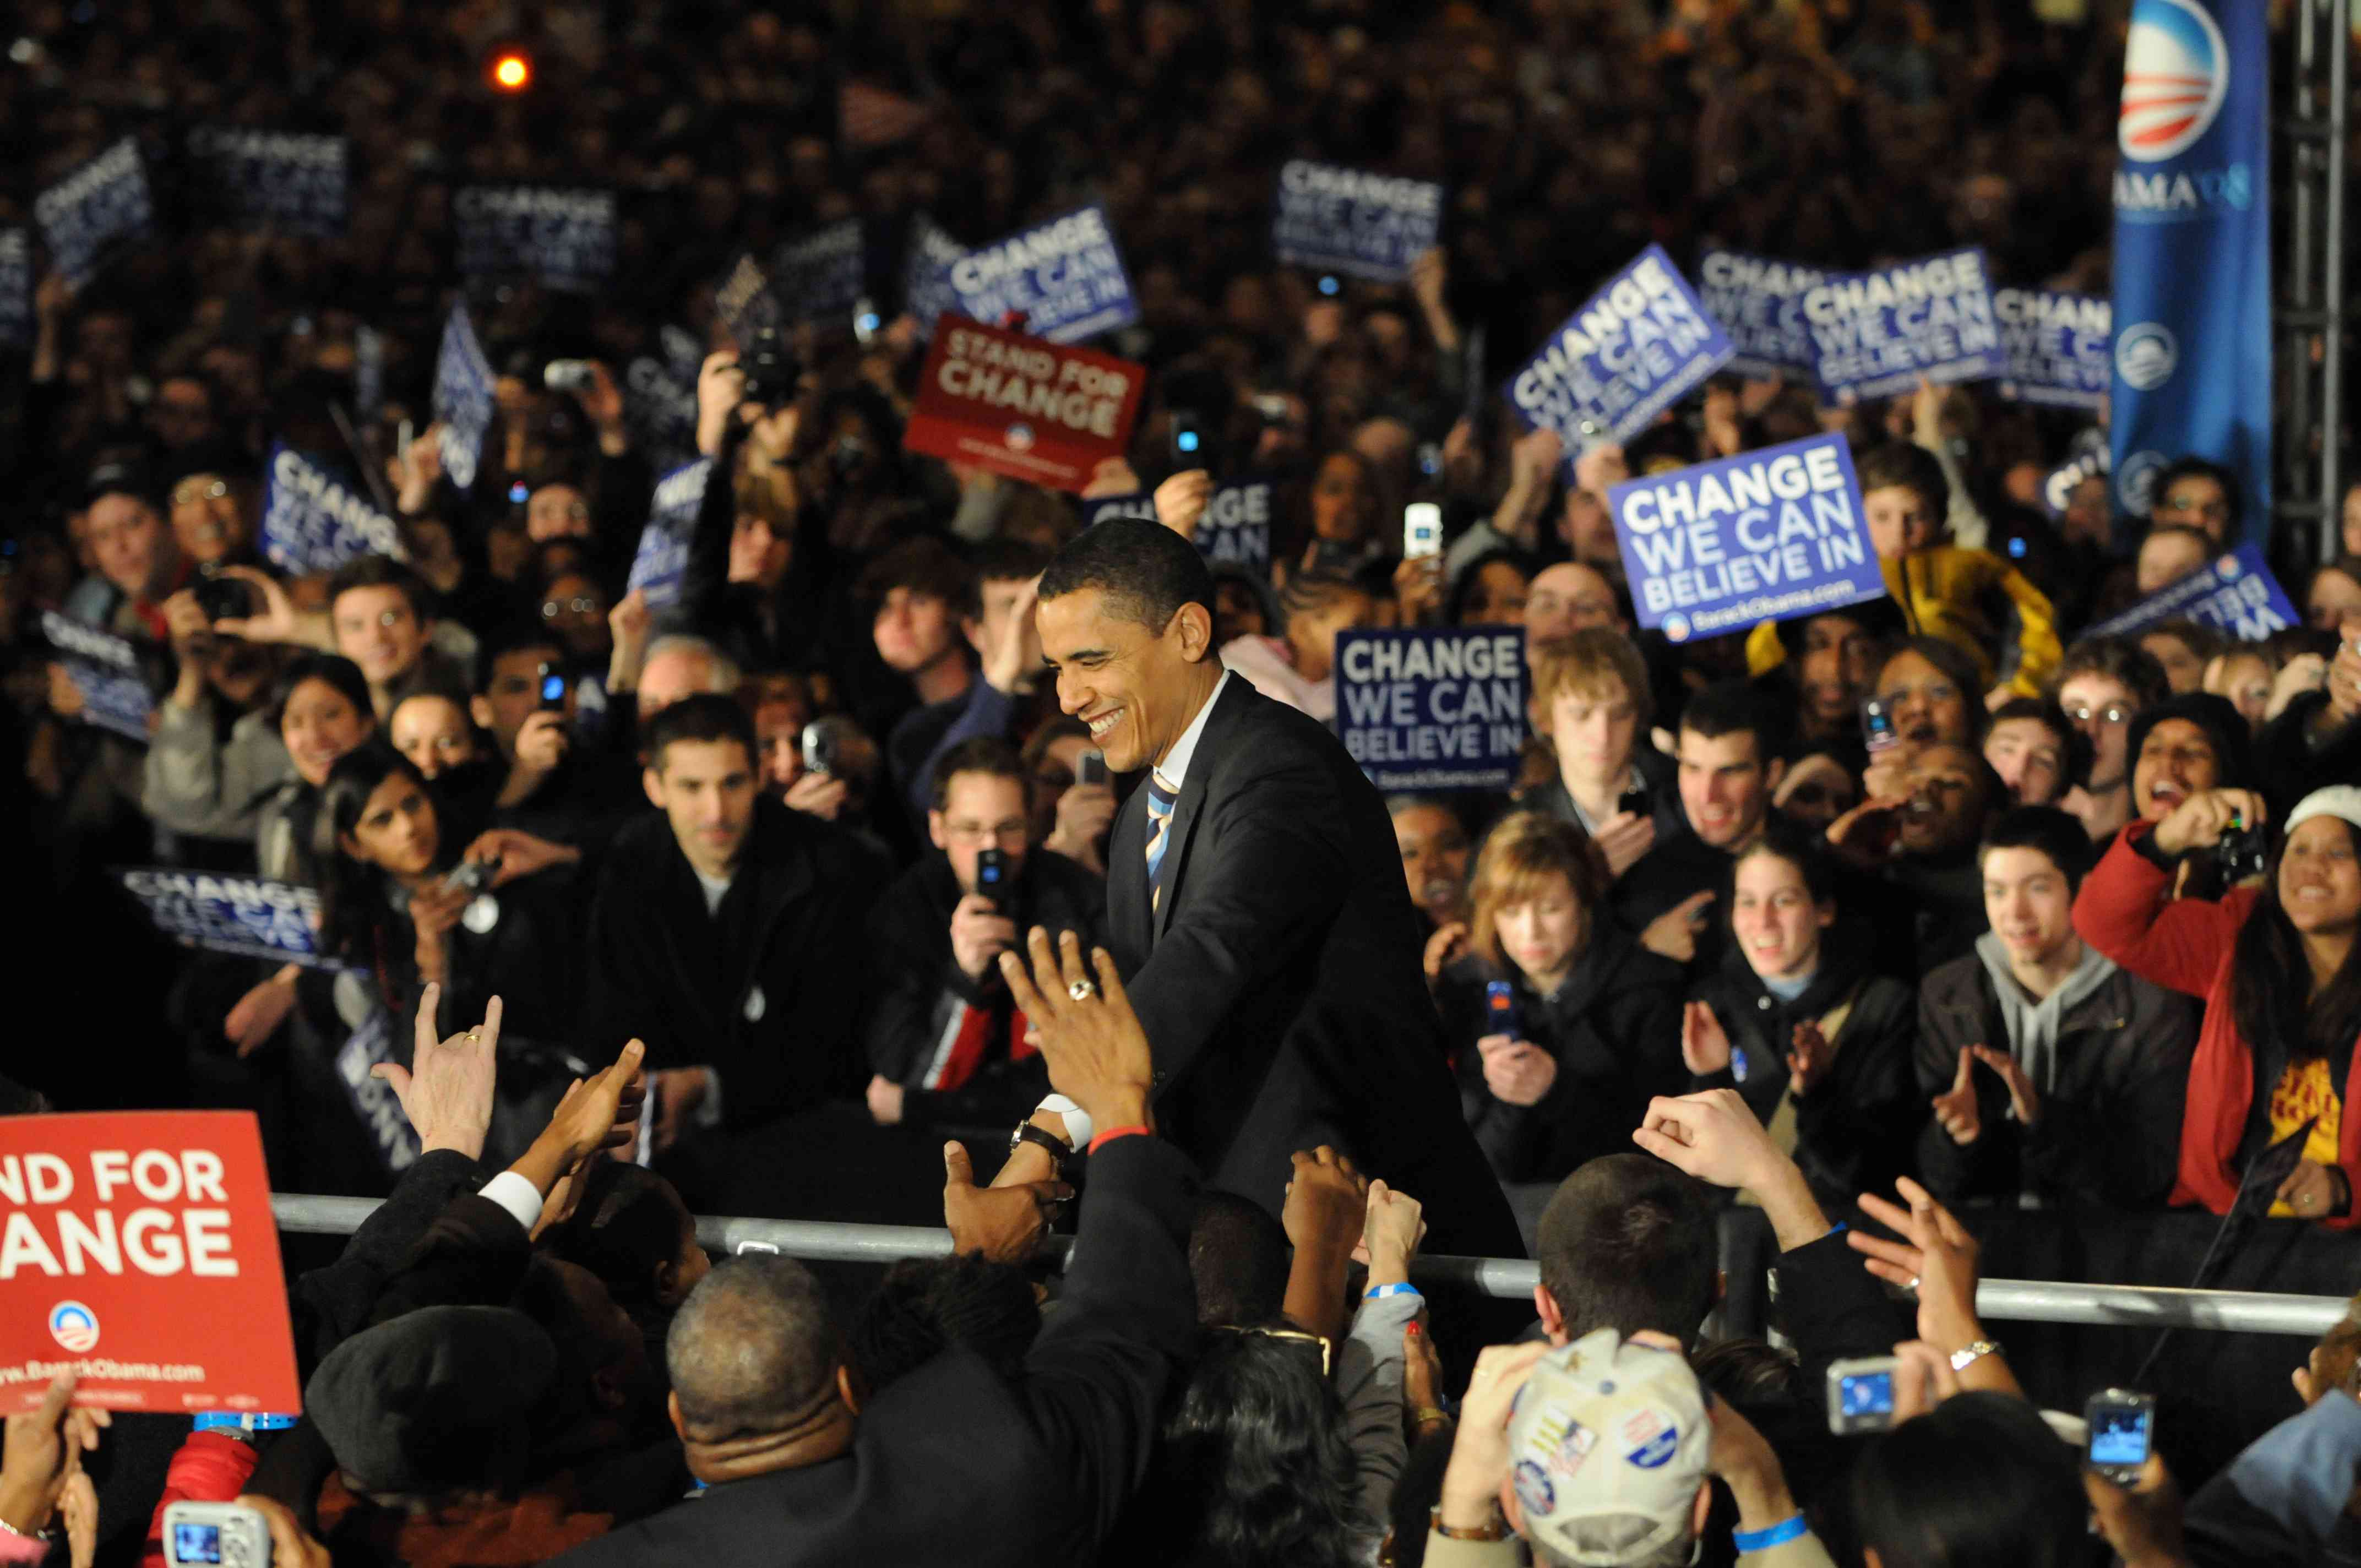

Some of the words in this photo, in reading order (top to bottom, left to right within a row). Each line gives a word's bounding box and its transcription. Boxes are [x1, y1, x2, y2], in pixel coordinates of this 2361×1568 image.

[1281, 159, 1443, 211] CHANGE
[951, 206, 1109, 295] CHANGE
[1035, 243, 1120, 295] CAN
[1803, 252, 1981, 326] CHANGE
[1514, 256, 1674, 410] CHANGE
[1600, 286, 1695, 372] CAN
[1811, 304, 1886, 358] WE
[1895, 290, 1993, 337] CAN
[949, 327, 1056, 380] STAND
[1059, 360, 1129, 398] FOR
[1820, 333, 1957, 385] BELIEVE
[938, 357, 1119, 439] CHANGE
[1623, 444, 1846, 534] CHANGE
[1630, 518, 1726, 577] WE
[1735, 488, 1856, 553] CAN
[1642, 542, 1813, 614] BELIEVE
[1818, 530, 1865, 573] IN
[1691, 579, 1856, 631] BarackObama.com
[1341, 635, 1521, 684] CHANGE
[1343, 682, 1419, 727] WE
[1428, 679, 1522, 723] CAN
[1344, 723, 1482, 763] BELIEVE
[1489, 723, 1524, 758] IN
[124, 871, 321, 908] CHANGE
[0, 1153, 75, 1204] ND
[90, 1149, 229, 1202] FOR
[0, 1207, 240, 1280] ANGE
